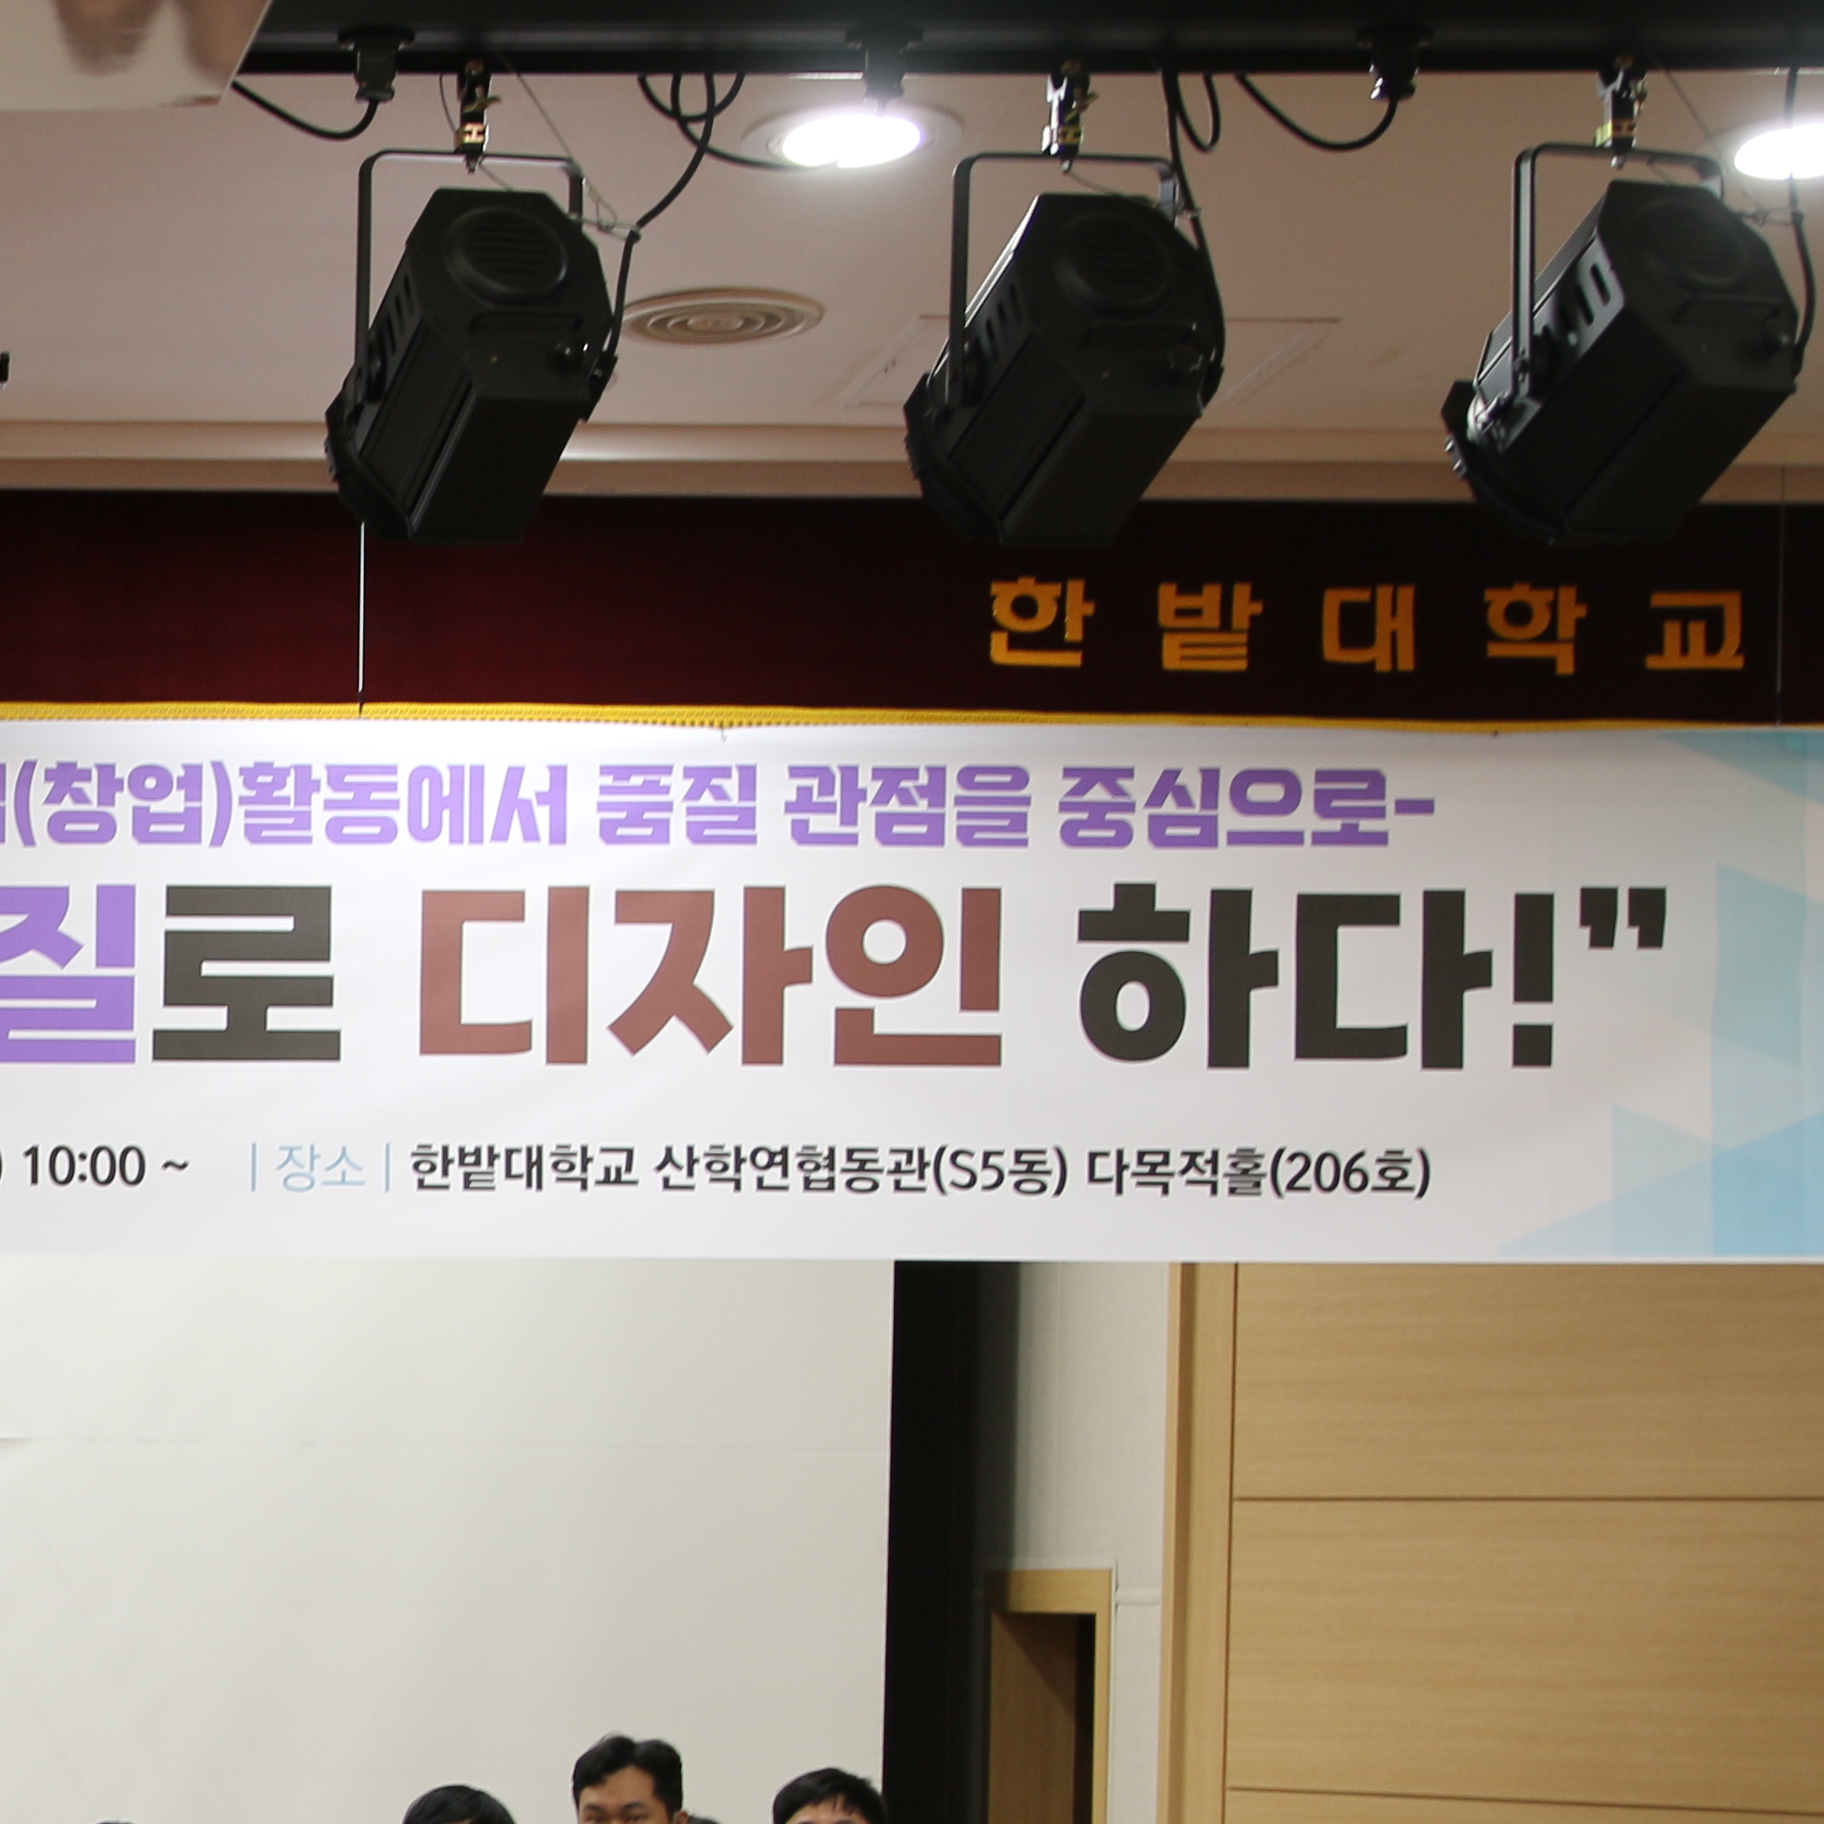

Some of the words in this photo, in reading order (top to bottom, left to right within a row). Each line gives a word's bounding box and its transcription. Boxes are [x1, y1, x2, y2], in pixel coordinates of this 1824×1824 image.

[597, 765, 756, 844] 품질
[785, 765, 1031, 847] 관점을
[1058, 766, 1435, 848] 중심으로-
[419, 884, 1002, 1067] 디자인
[22, 1144, 146, 1187] 10:00
[275, 1142, 366, 1191] 장소
[409, 1143, 639, 1192] 한밭대학교
[654, 1143, 1068, 1198] 산학연협동관(S5동)
[1086, 1145, 1432, 1201] 다목적홀(206호)
